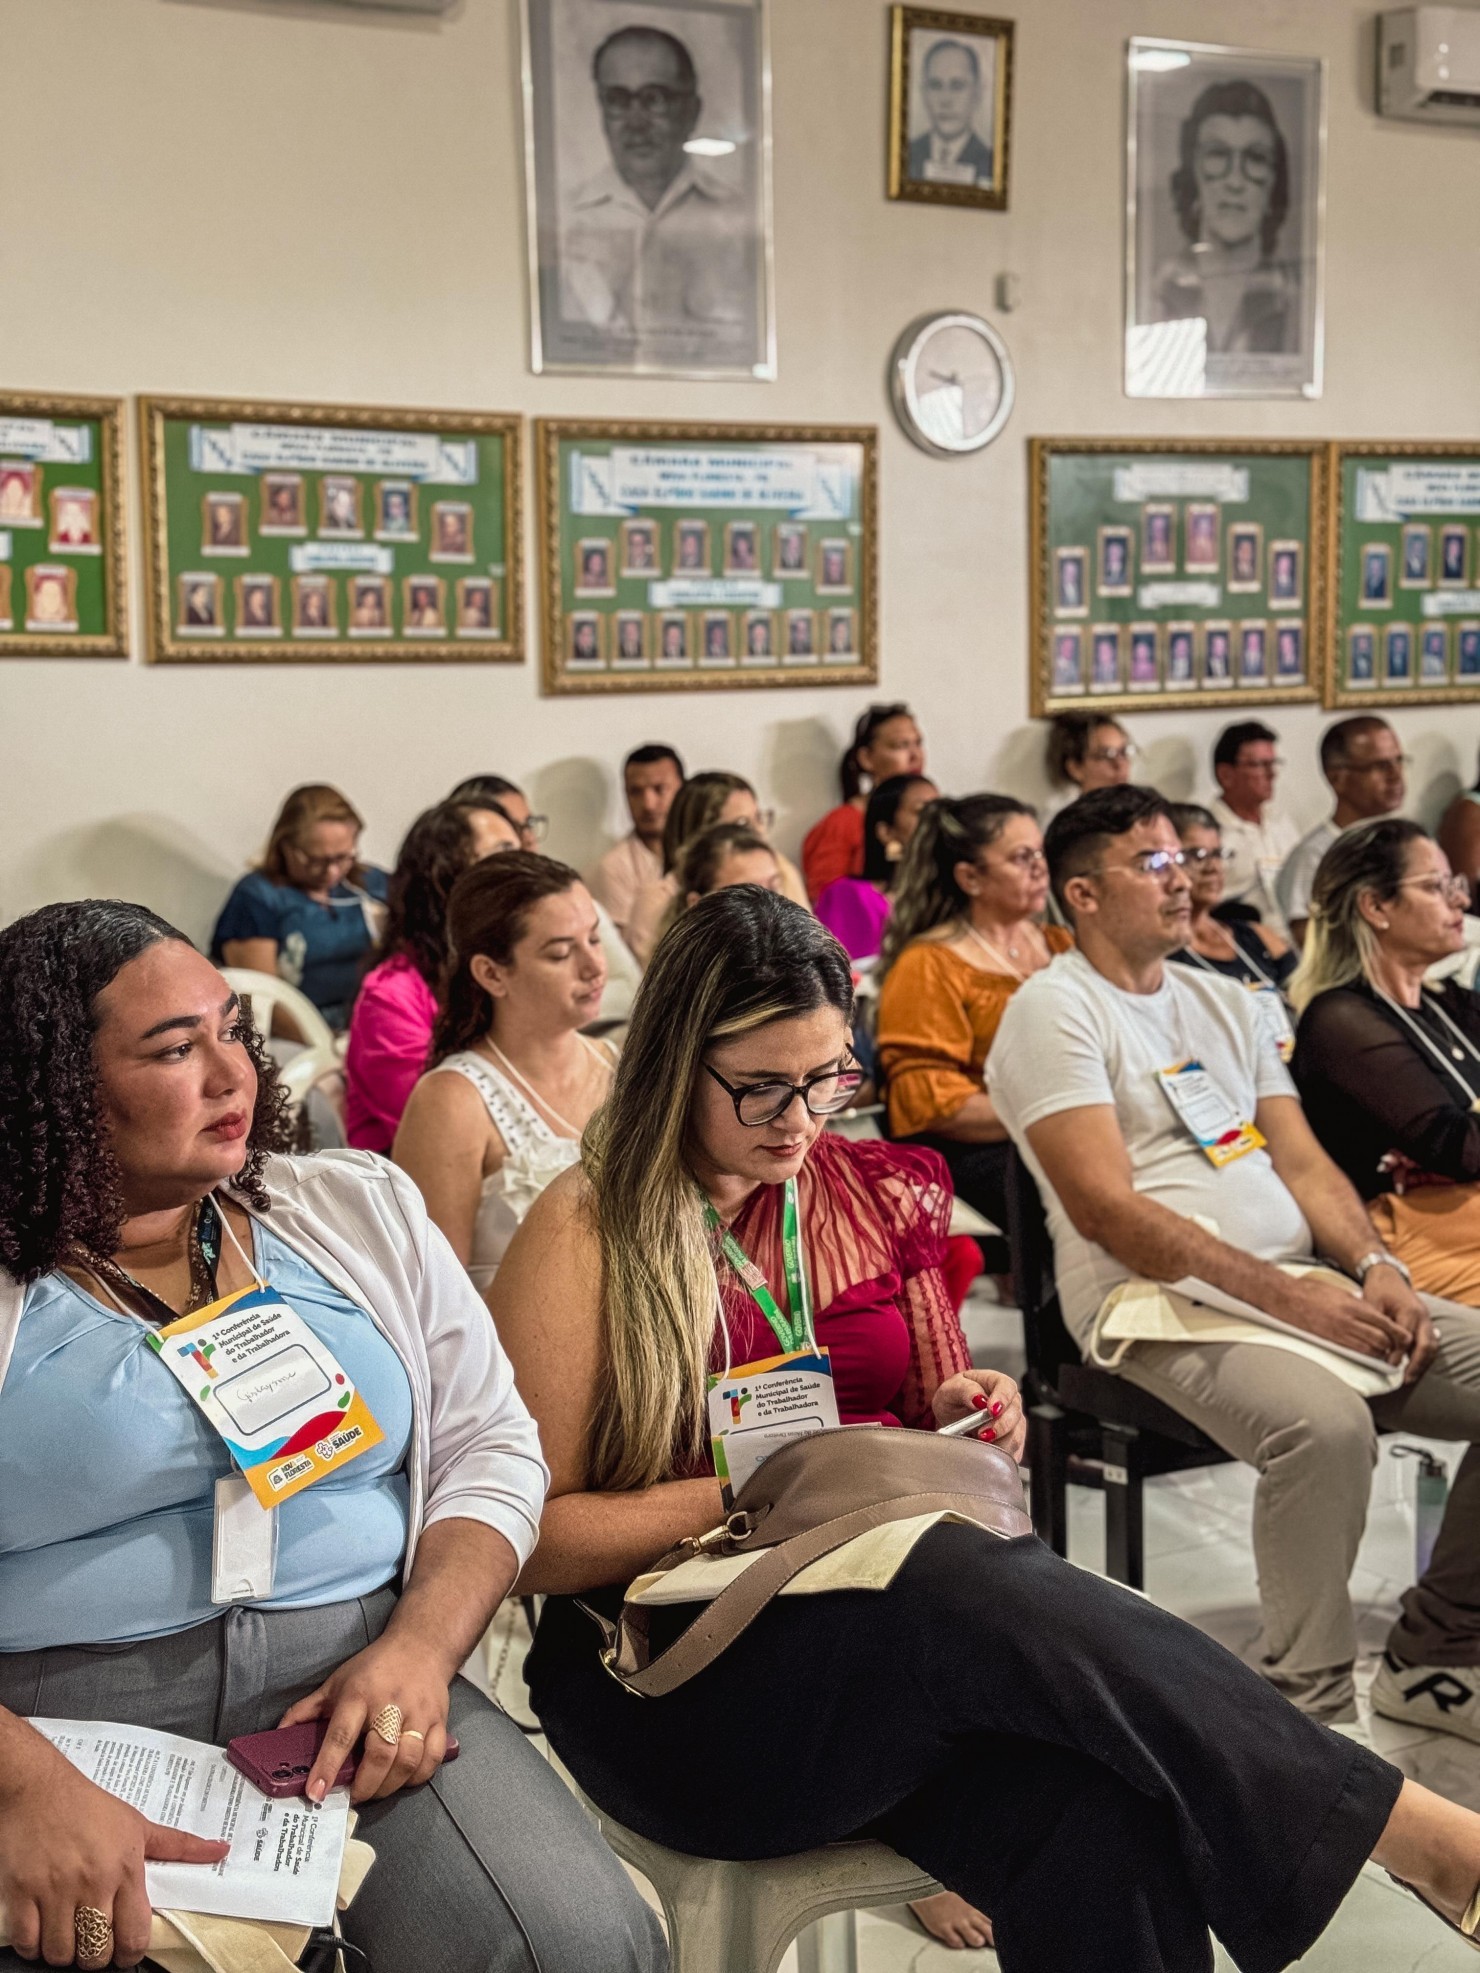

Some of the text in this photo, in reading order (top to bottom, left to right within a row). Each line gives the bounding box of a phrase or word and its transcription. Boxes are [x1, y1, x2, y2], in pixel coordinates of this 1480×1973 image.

[218, 1312, 282, 1348] Municipal de Saúde
[220, 1312, 261, 1336] Conferência
[770, 1316, 790, 1347] GOVERNO
[225, 1325, 276, 1356] do Trabalhador
[237, 1350, 247, 1361] da
[246, 1330, 291, 1355] Trabalhadora
[755, 1381, 821, 1400] Municipal de Saúde
[763, 1377, 803, 1390] Conferência
[756, 1393, 809, 1409] do Trabalhador
[763, 1408, 773, 1416] da
[773, 1400, 819, 1414] Trabalhadora
[332, 1427, 362, 1449] SAÚDE
[284, 1460, 312, 1480] FLORESTA
[282, 1817, 290, 1828] da
[284, 1813, 300, 1868] do Trabalhador
